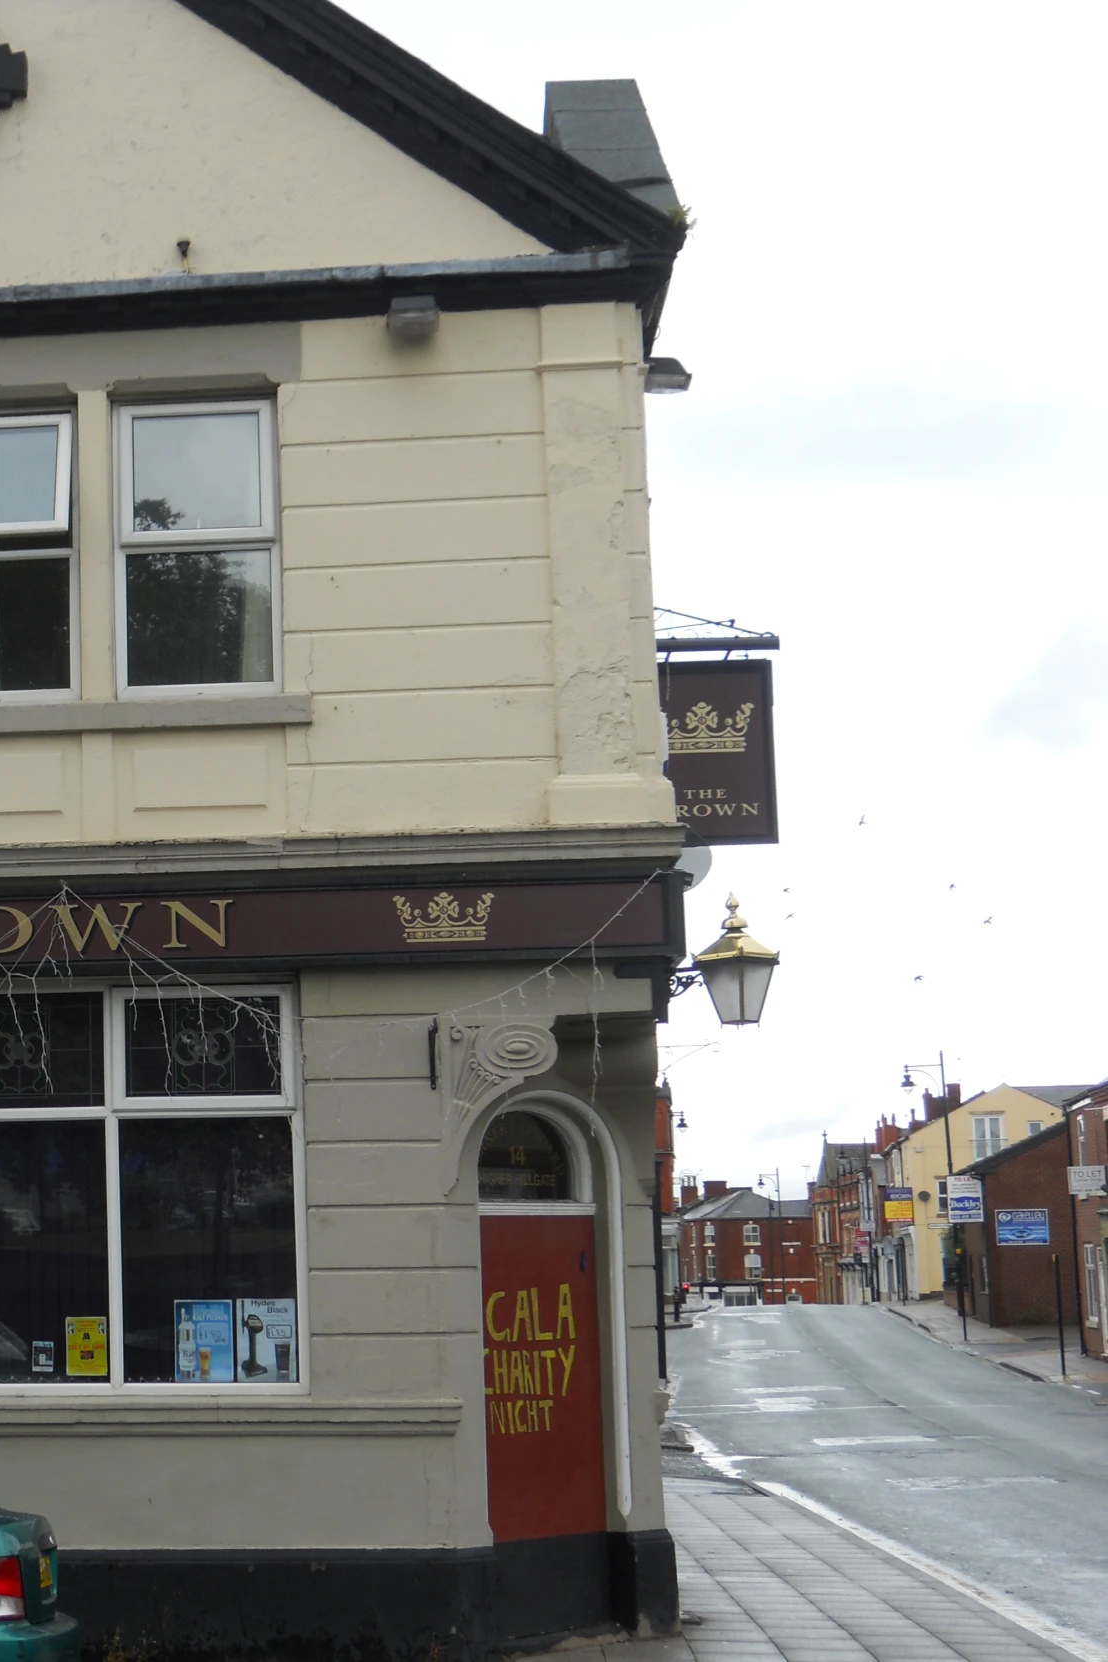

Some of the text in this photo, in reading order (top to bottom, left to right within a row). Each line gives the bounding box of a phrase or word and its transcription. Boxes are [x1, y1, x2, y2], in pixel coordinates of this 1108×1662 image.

[684, 788, 727, 799] THE
[675, 802, 760, 817] ROWN
[1072, 1170, 1102, 1178] TO LET
[950, 1200, 981, 1209] Buckley
[250, 1299, 276, 1308] Hydes
[267, 1306, 289, 1314] Black
